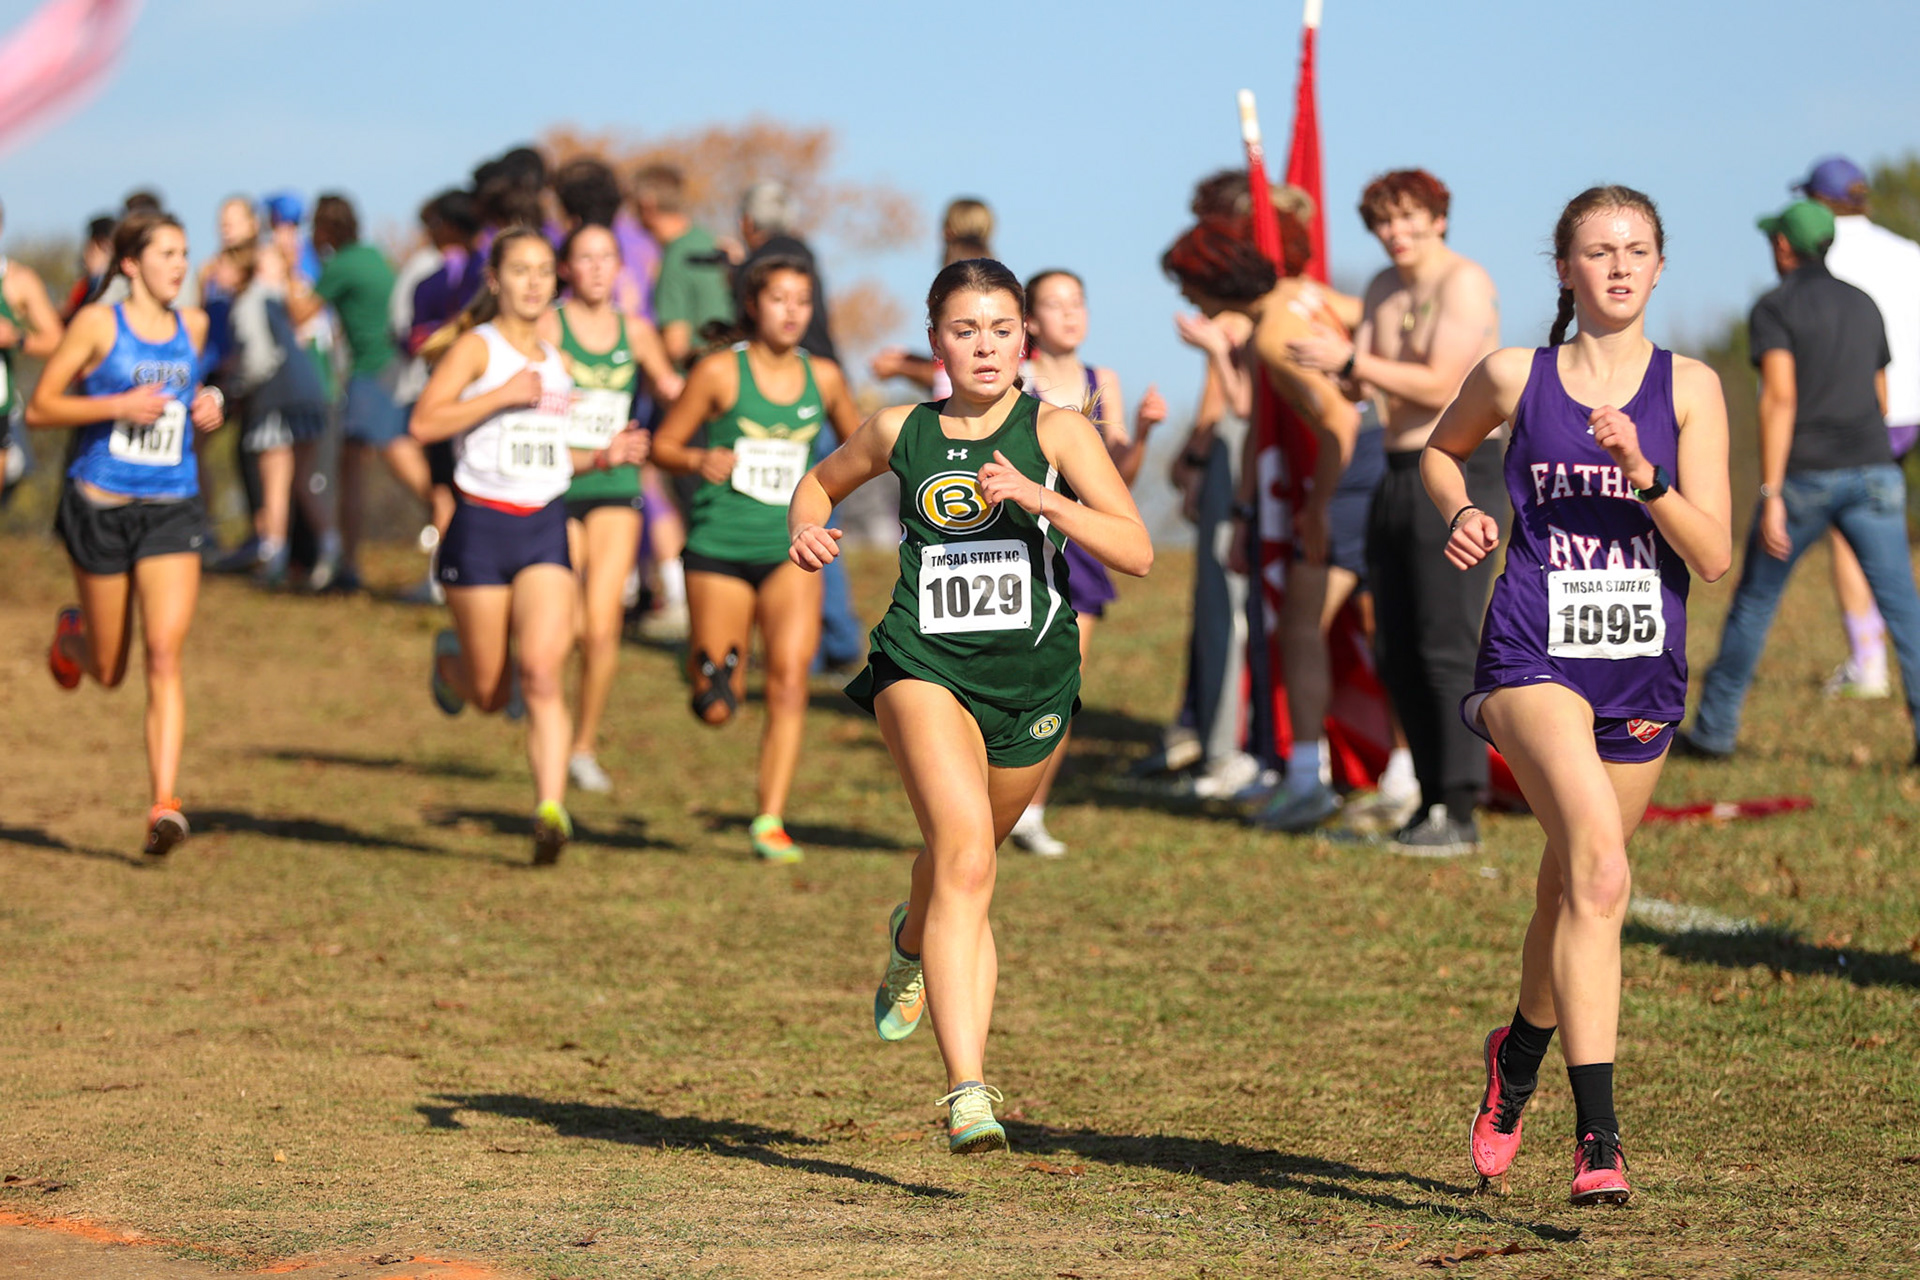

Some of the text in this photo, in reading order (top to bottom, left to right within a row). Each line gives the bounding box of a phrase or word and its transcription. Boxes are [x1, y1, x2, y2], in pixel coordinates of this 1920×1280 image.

[132, 361, 190, 390] GPS
[933, 484, 981, 524] B
[1530, 462, 1642, 506] FATH
[931, 550, 1020, 567] TMSAA STATE XC
[1548, 523, 1657, 570] RYAN
[926, 573, 1022, 618] 1029
[1562, 580, 1651, 594] TMSAA STATE XC
[1557, 603, 1657, 645] 1095
